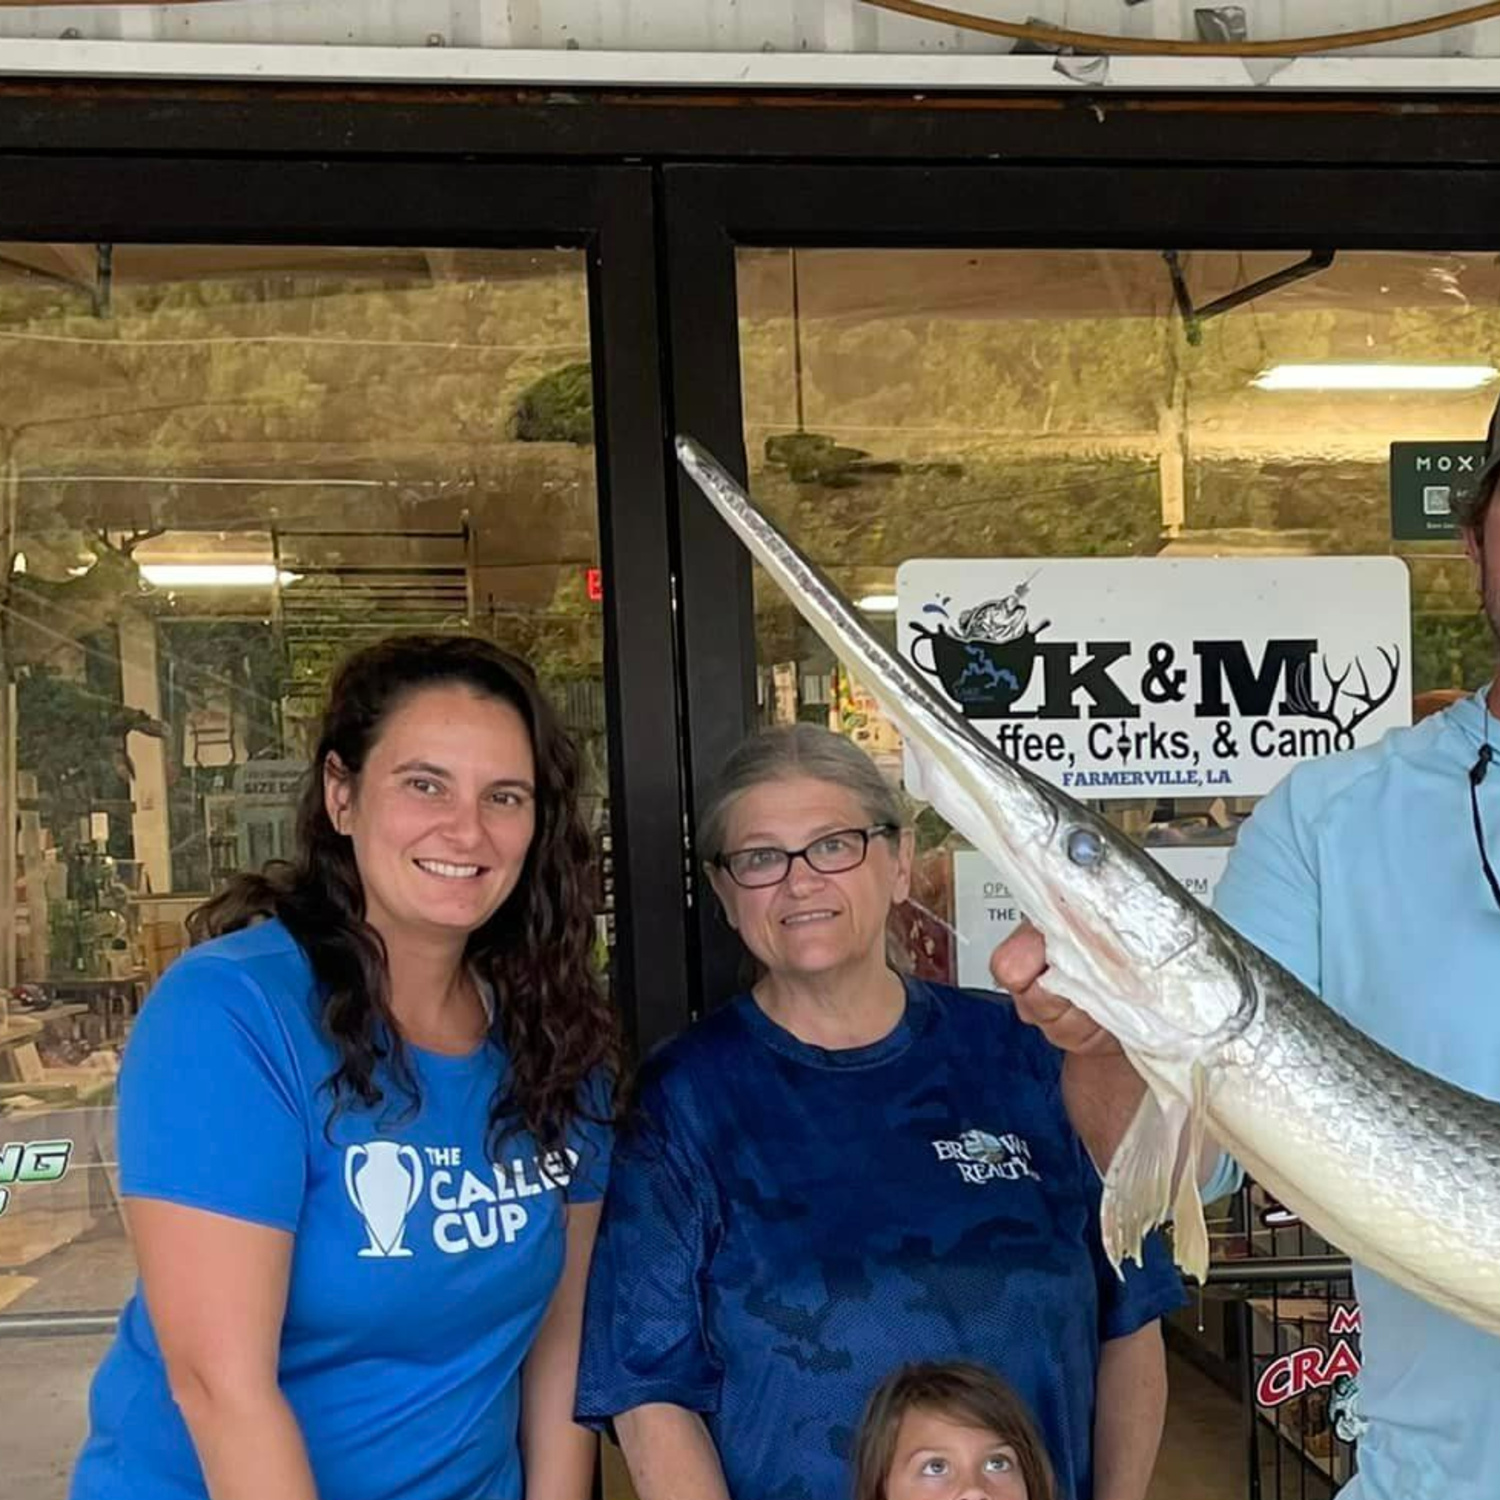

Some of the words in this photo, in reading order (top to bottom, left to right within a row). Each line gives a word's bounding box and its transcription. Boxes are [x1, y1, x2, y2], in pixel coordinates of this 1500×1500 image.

[996, 724, 1075, 767] ffee,
[1213, 721, 1239, 758] &
[1062, 770, 1203, 787] FARMERVILLE,
[1206, 769, 1232, 784] LA
[988, 908, 1016, 921] THE
[425, 1147, 461, 1166] THE
[433, 1203, 528, 1253] CUP
